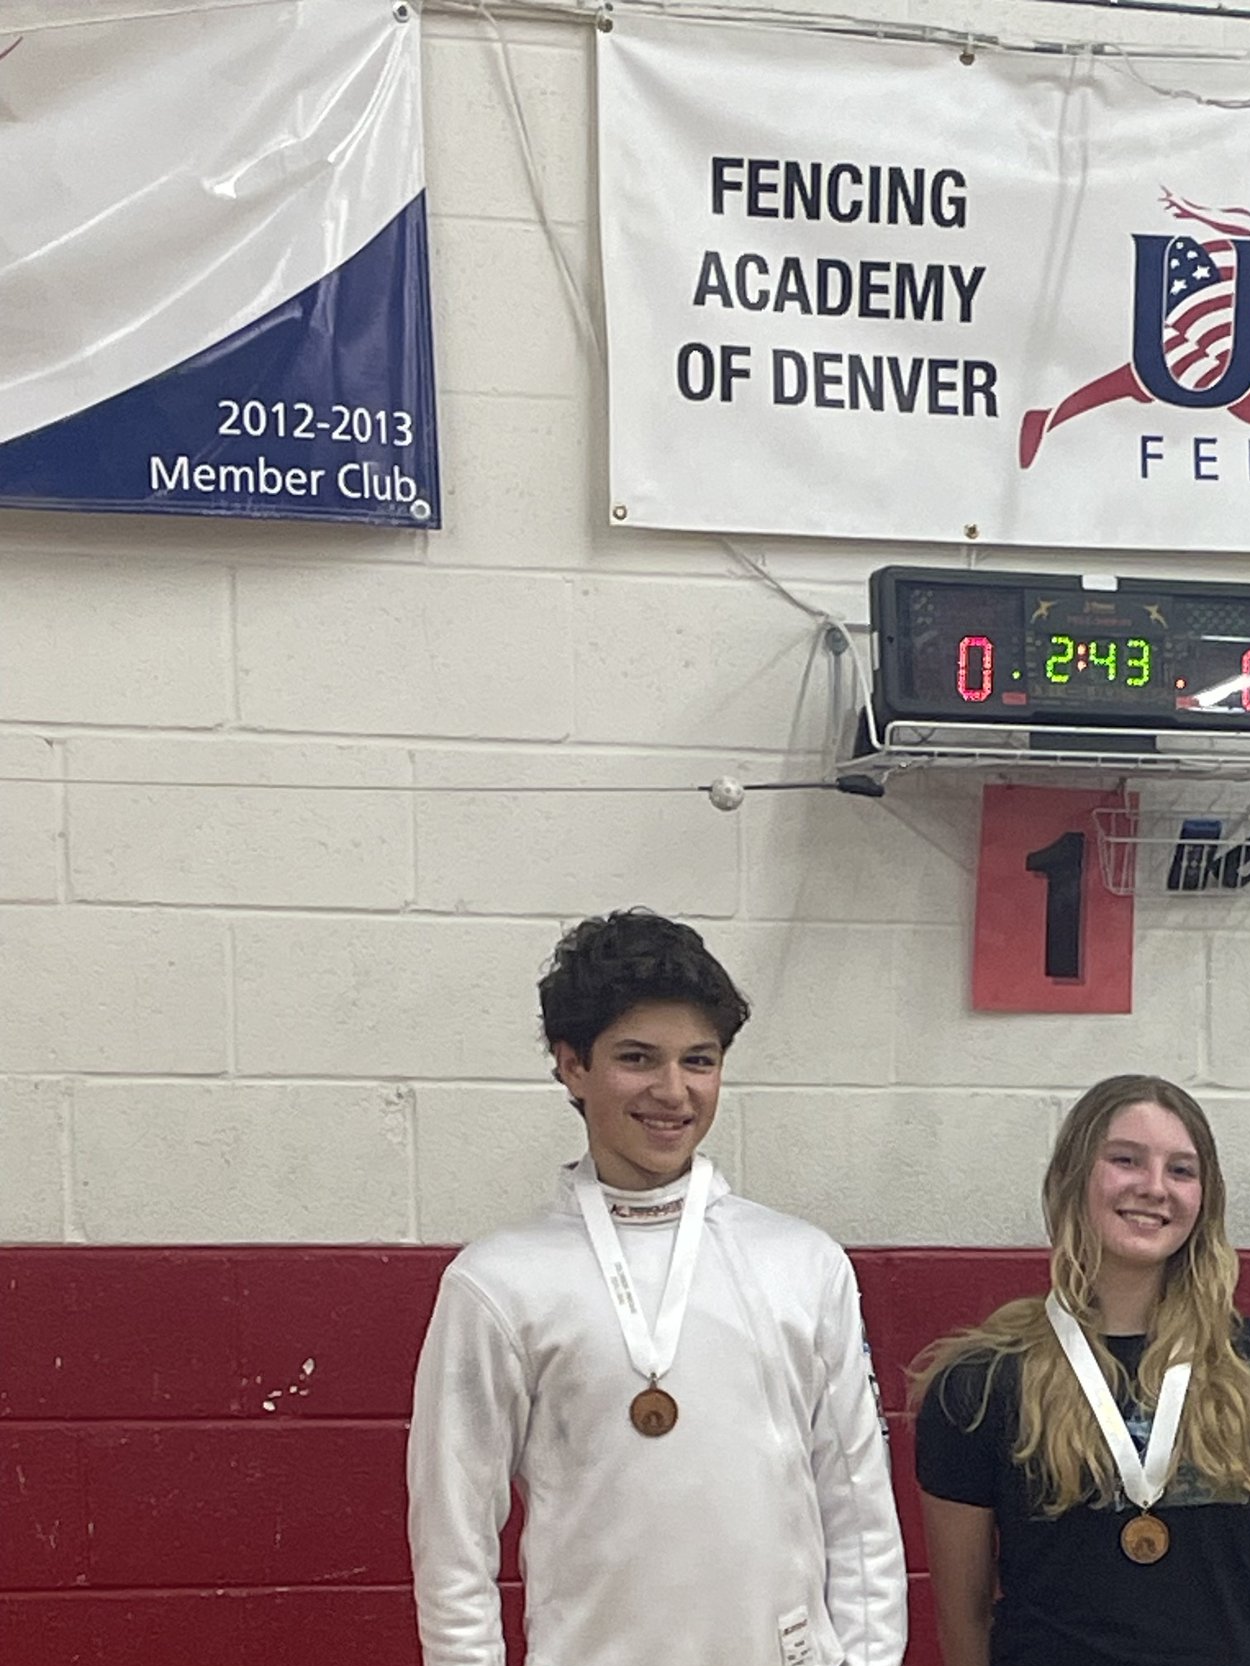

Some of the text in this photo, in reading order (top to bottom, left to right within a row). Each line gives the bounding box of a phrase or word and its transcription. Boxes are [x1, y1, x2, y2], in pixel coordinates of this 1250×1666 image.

[711, 156, 967, 229] FENCING
[692, 250, 987, 323] ACADEMY
[677, 342, 999, 418] OF DENVER
[217, 400, 413, 446] 2012-2013
[149, 455, 416, 501] Member Club
[957, 636, 993, 701] 0
[1046, 636, 1150, 687] 2:43
[1025, 831, 1085, 978] 1
